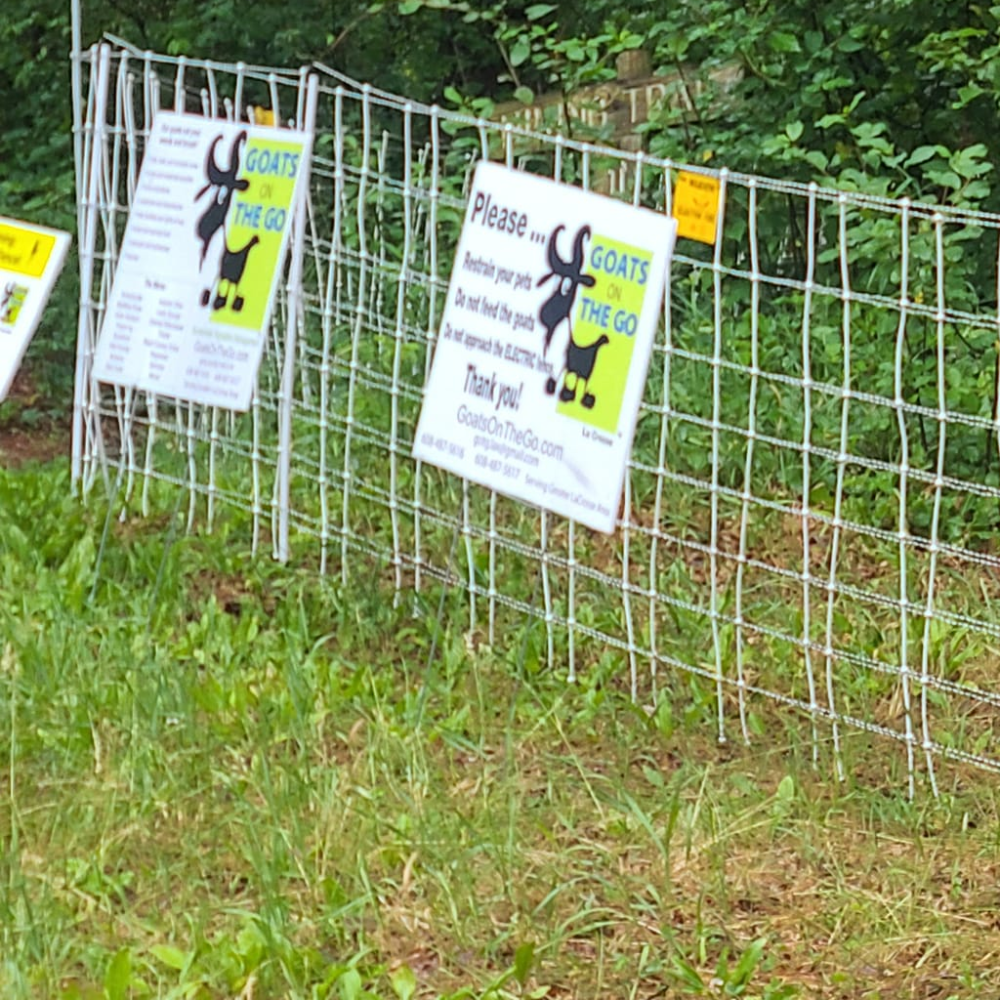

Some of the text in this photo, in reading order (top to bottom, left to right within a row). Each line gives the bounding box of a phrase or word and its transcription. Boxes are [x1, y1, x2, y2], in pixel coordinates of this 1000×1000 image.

[246, 148, 299, 178] GOATS
[234, 202, 287, 232] THE GO
[471, 191, 528, 237] Please
[463, 250, 532, 291] Restrain your pets
[591, 246, 649, 285] GOATS
[454, 287, 535, 332] Do not feed the goats
[607, 283, 622, 302] ON
[581, 297, 638, 337] THE GO
[463, 362, 523, 411] Thank you!
[457, 403, 564, 461] GoatsOnTheGo.com
